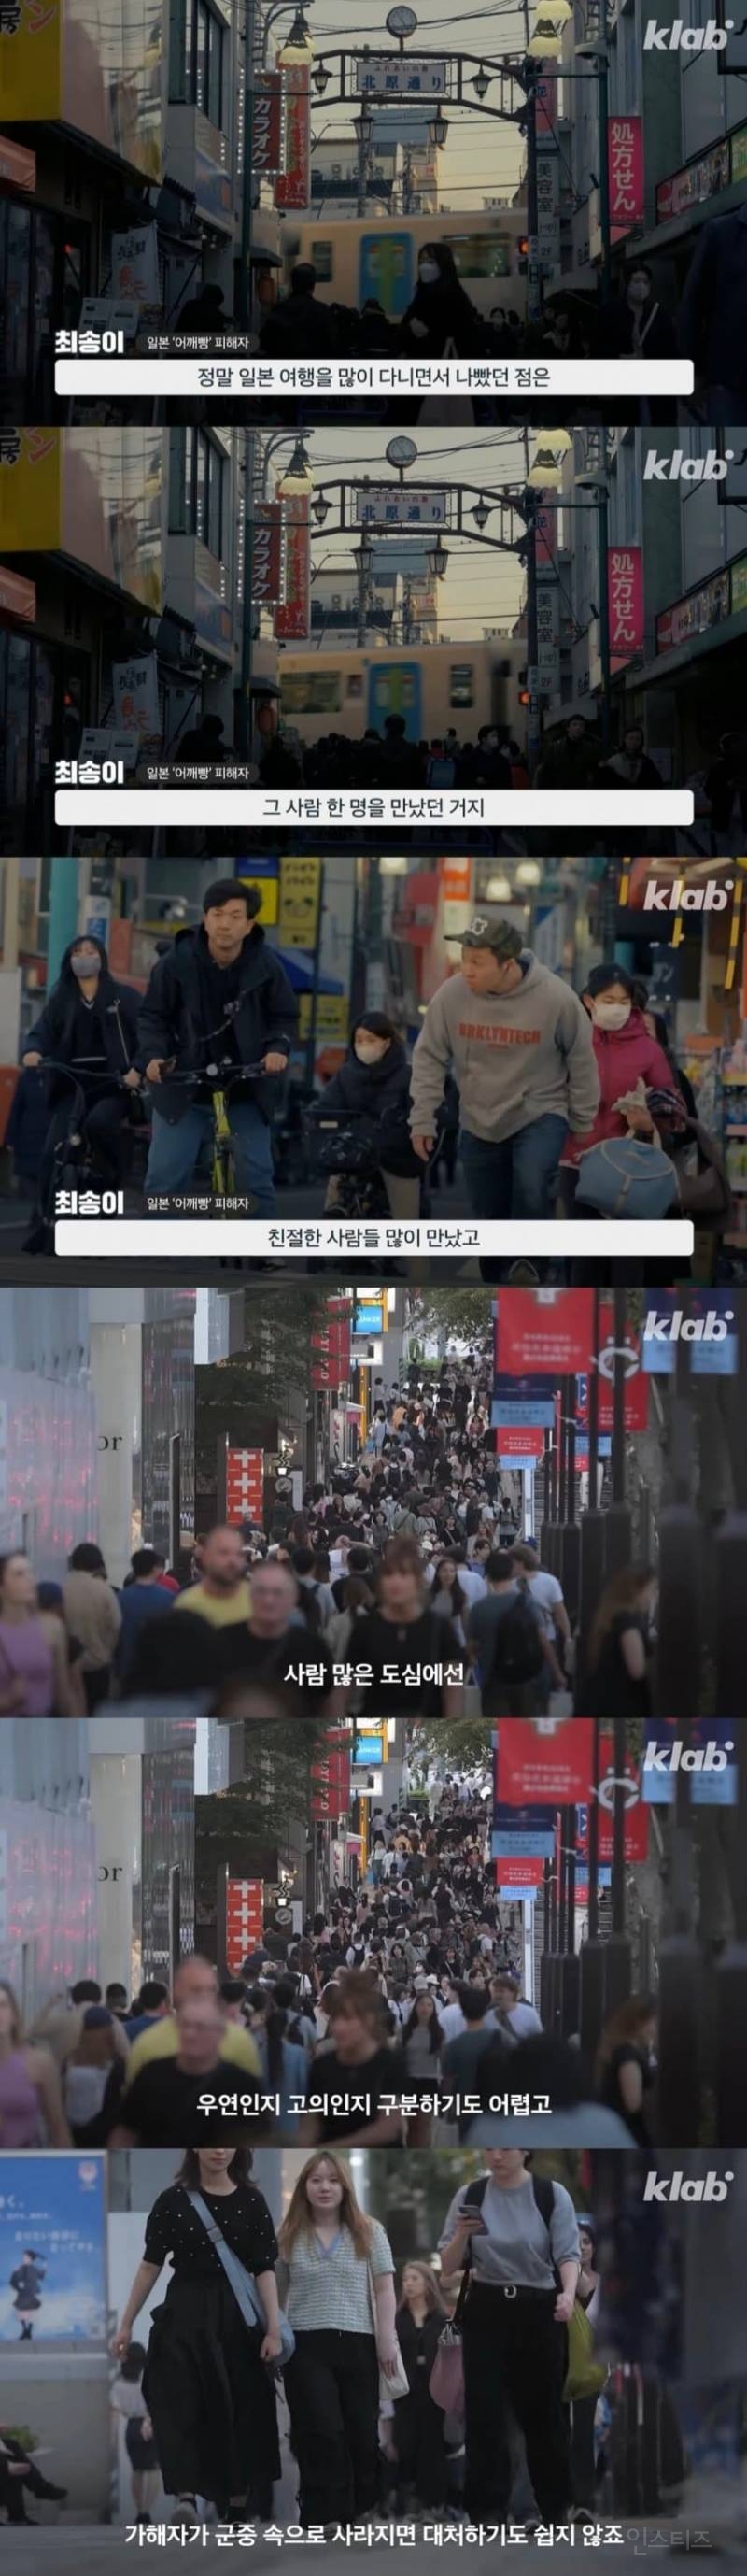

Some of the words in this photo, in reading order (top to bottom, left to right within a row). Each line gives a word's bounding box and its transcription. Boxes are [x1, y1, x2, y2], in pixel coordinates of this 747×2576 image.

[361, 75, 441, 90] 北原通り
[251, 97, 272, 166] カラオケ
[537, 163, 553, 212] 美容室
[611, 121, 636, 212] 処方せん
[361, 505, 441, 520] 北原通り
[251, 528, 272, 597] カラオケ
[537, 593, 553, 643] 美容室
[611, 552, 636, 642] 処方せん
